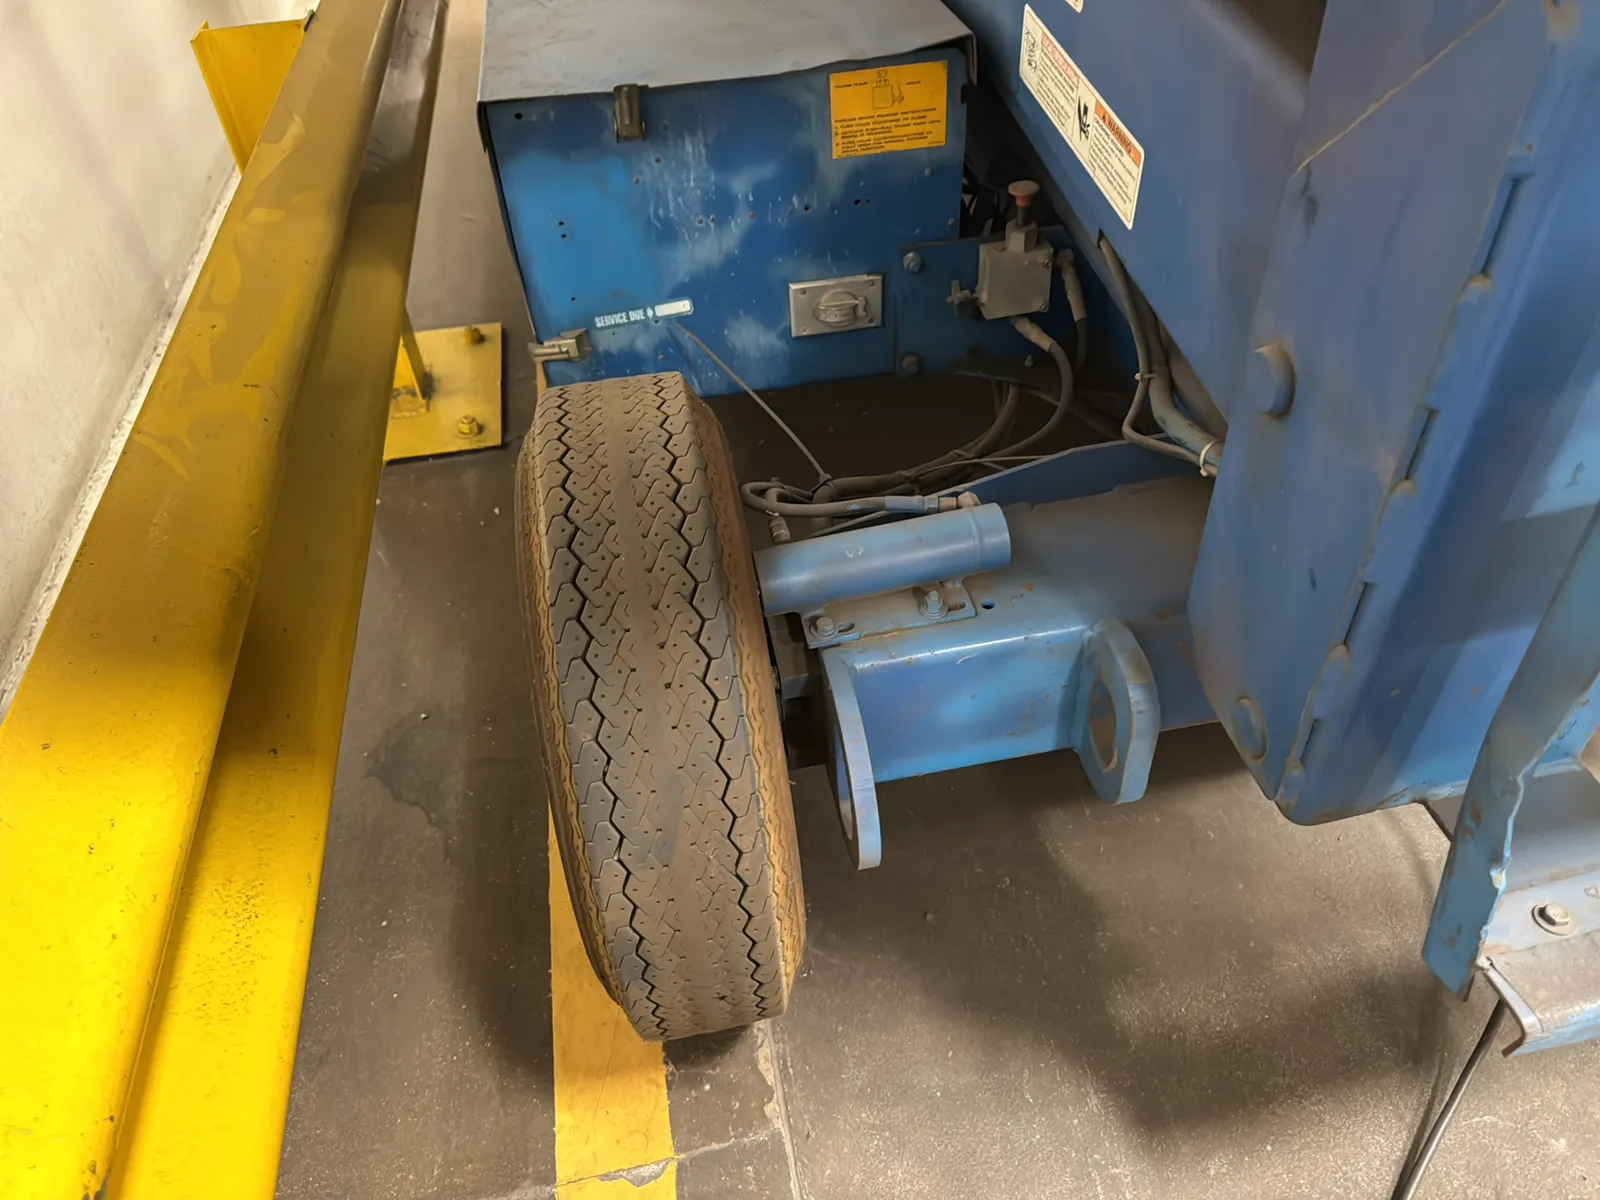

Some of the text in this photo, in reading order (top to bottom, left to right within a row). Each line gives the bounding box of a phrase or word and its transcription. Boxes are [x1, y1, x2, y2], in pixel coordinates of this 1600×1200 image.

[1107, 115, 1132, 155] WARNING
[594, 308, 645, 328] SERVICE DUE
